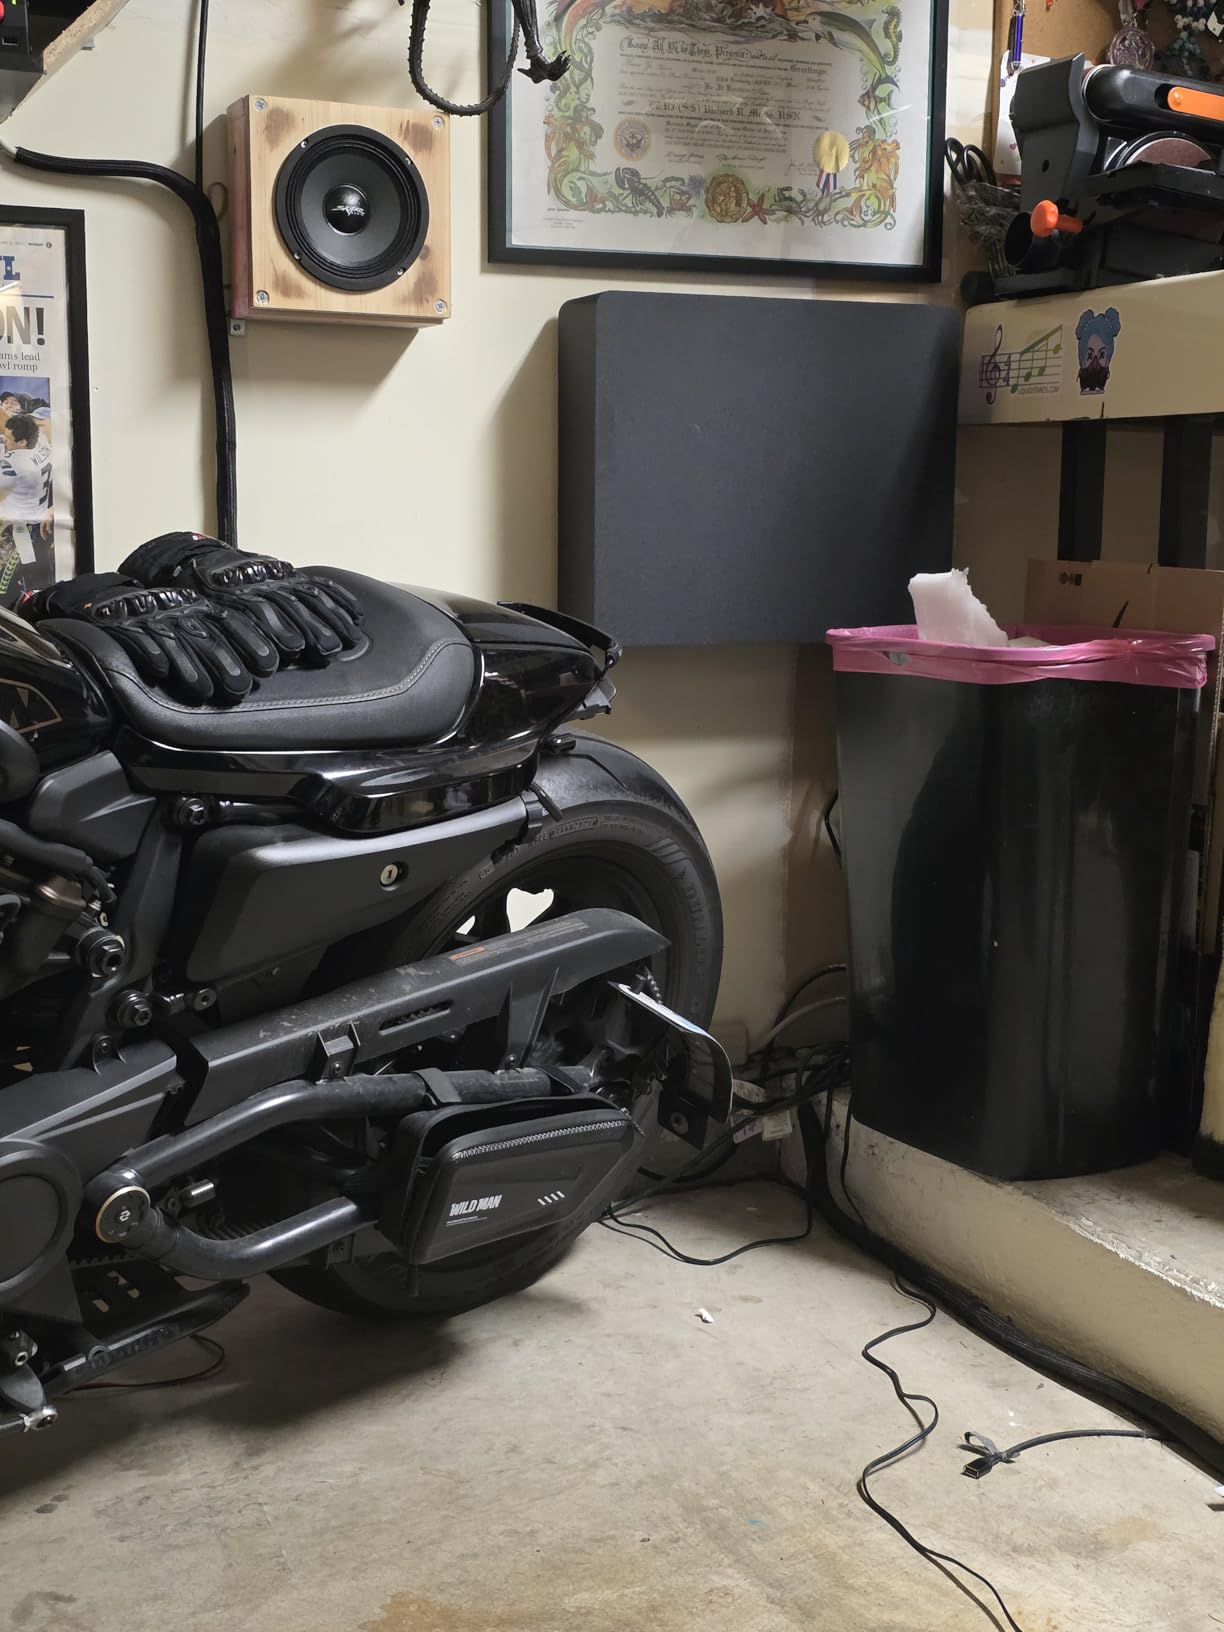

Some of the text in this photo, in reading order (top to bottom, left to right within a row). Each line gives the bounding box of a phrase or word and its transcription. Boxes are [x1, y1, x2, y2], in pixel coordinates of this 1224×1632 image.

[652, 40, 664, 53] All
[0, 255, 20, 281] L
[21, 351, 41, 361] lead
[13, 363, 38, 373] romp
[449, 1194, 502, 1217] WILD MAN
